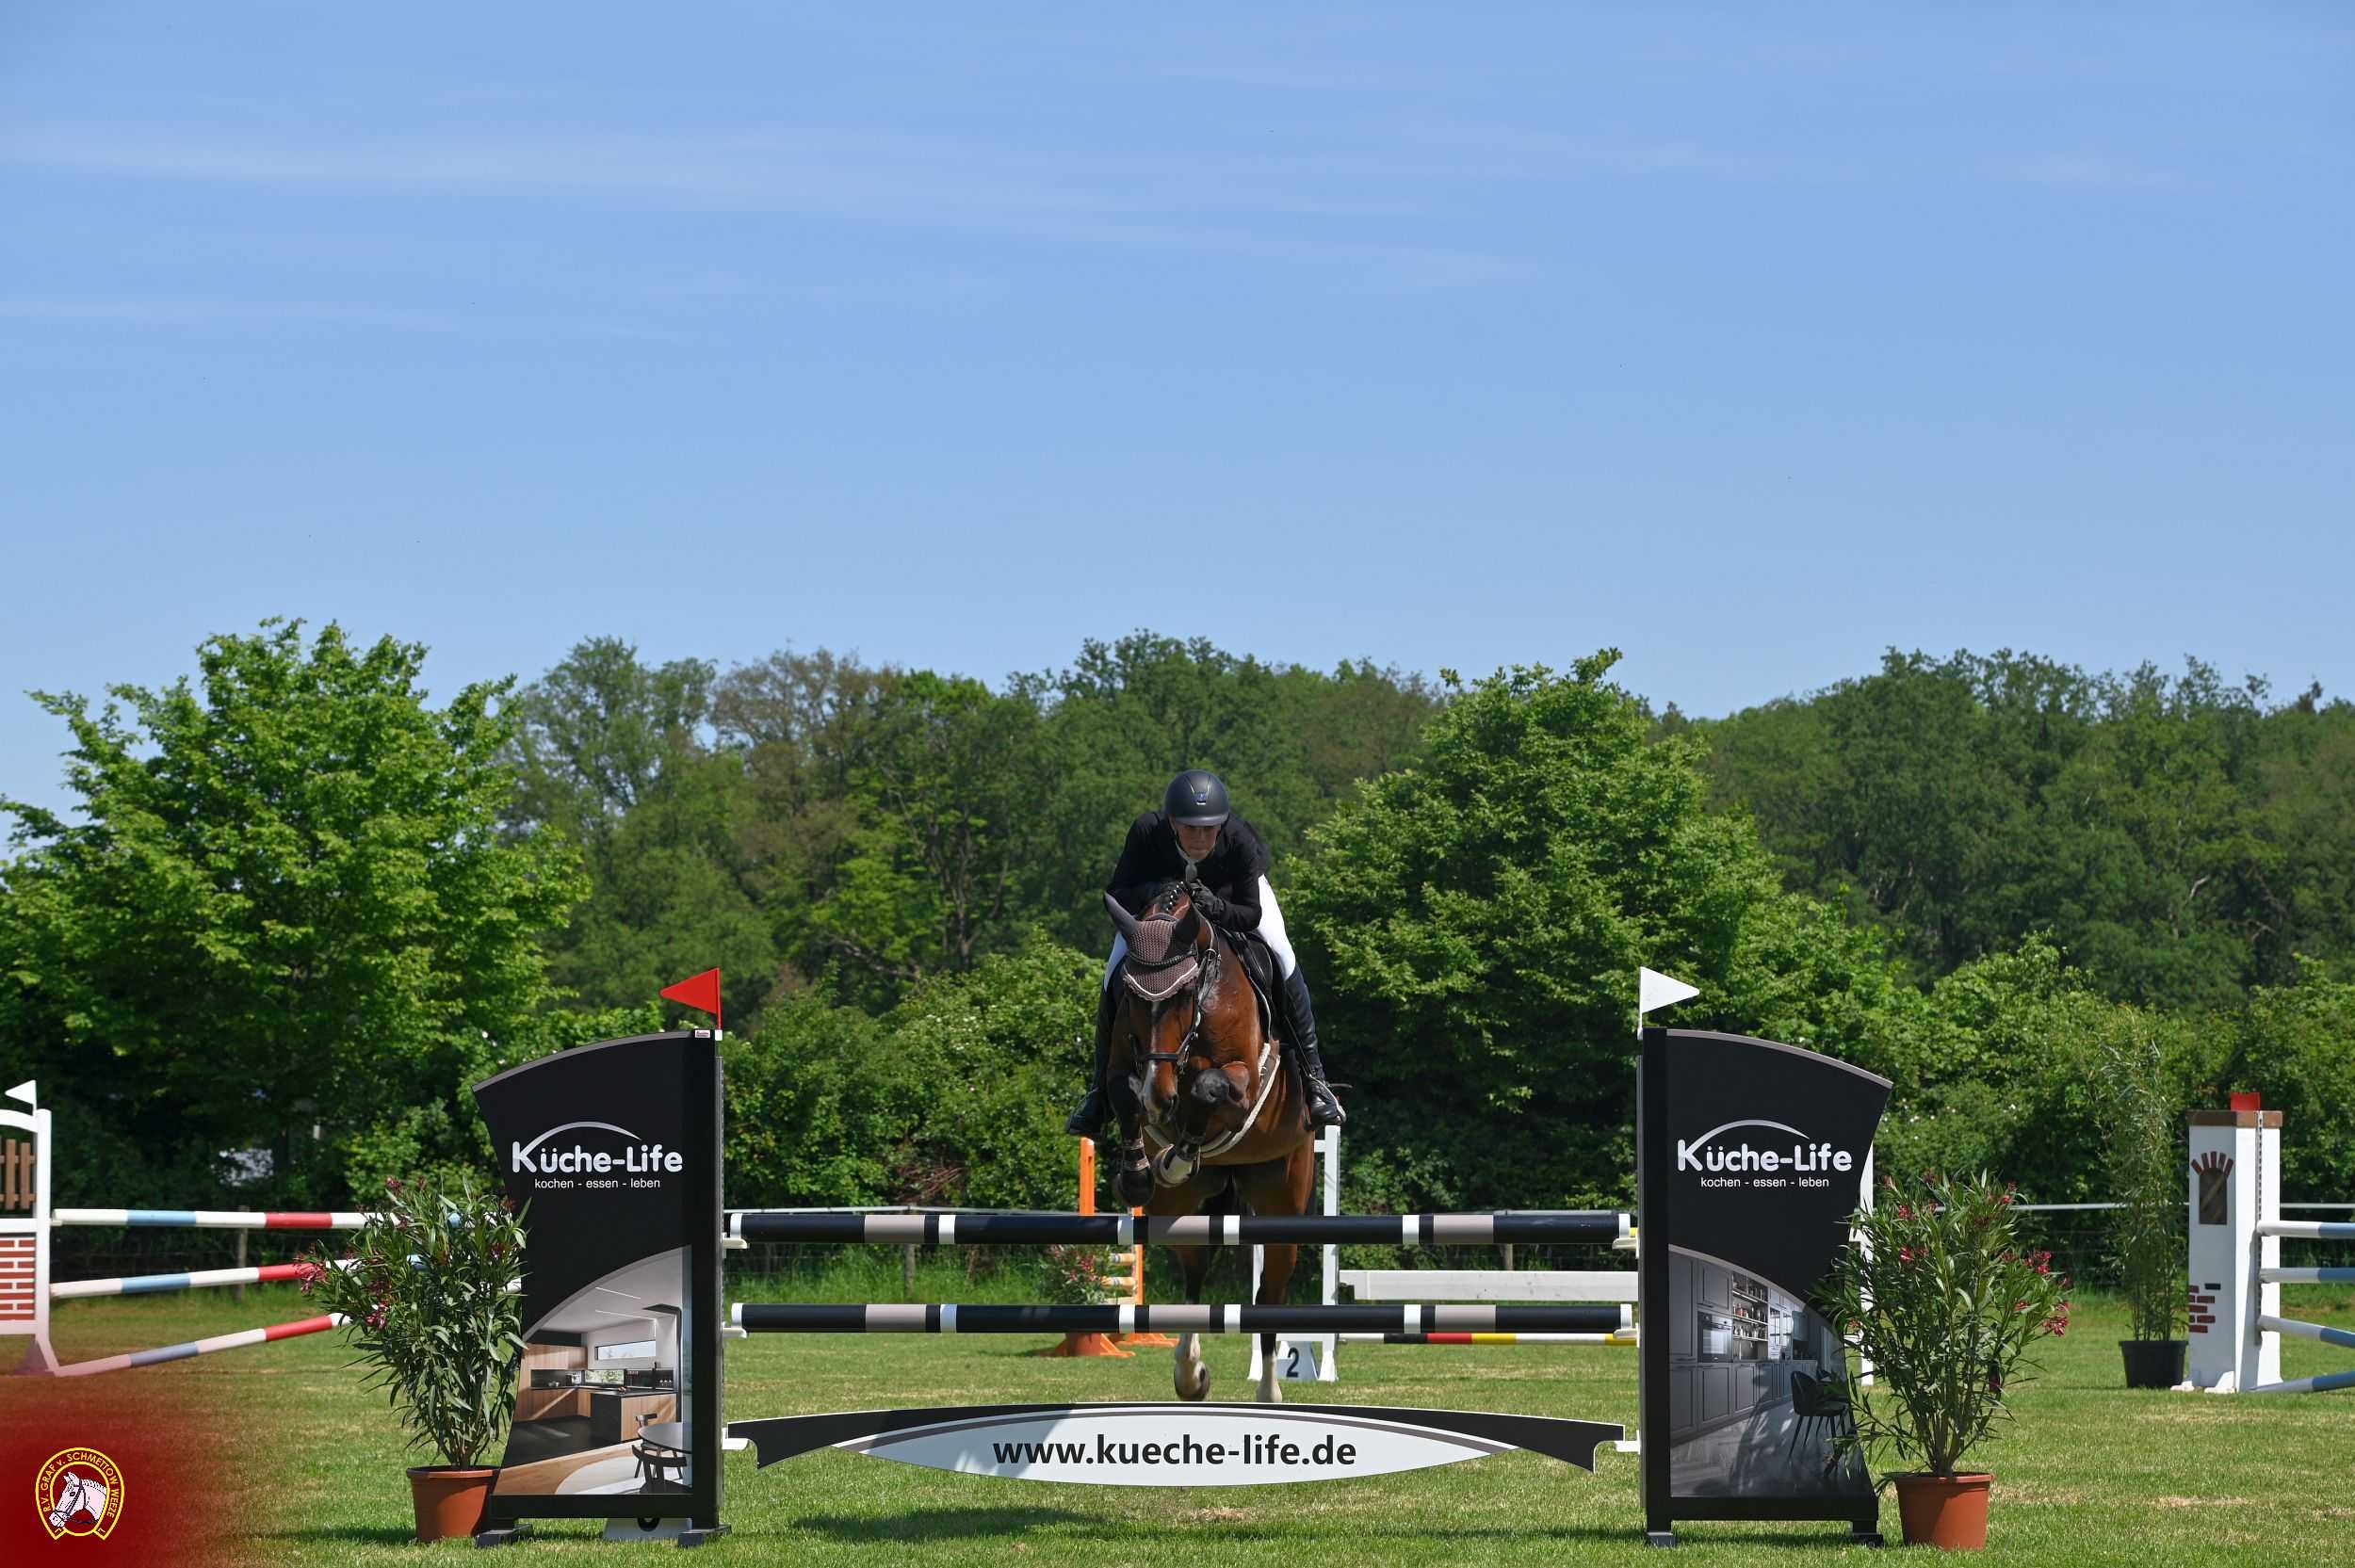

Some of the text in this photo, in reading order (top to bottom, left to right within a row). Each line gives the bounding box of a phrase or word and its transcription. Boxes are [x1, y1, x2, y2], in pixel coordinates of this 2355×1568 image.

[512, 1140, 684, 1173] Küche-Life
[1677, 1139, 1853, 1172] Küche-Life
[534, 1178, 574, 1188] kochen
[585, 1179, 619, 1188] essen
[630, 1178, 660, 1188] leben
[1700, 1177, 1741, 1188] kochen
[1752, 1179, 1787, 1188] essen
[1798, 1177, 1829, 1188] leben
[1285, 1347, 1300, 1378] 2
[992, 1433, 1357, 1465] www.kueche-life.de
